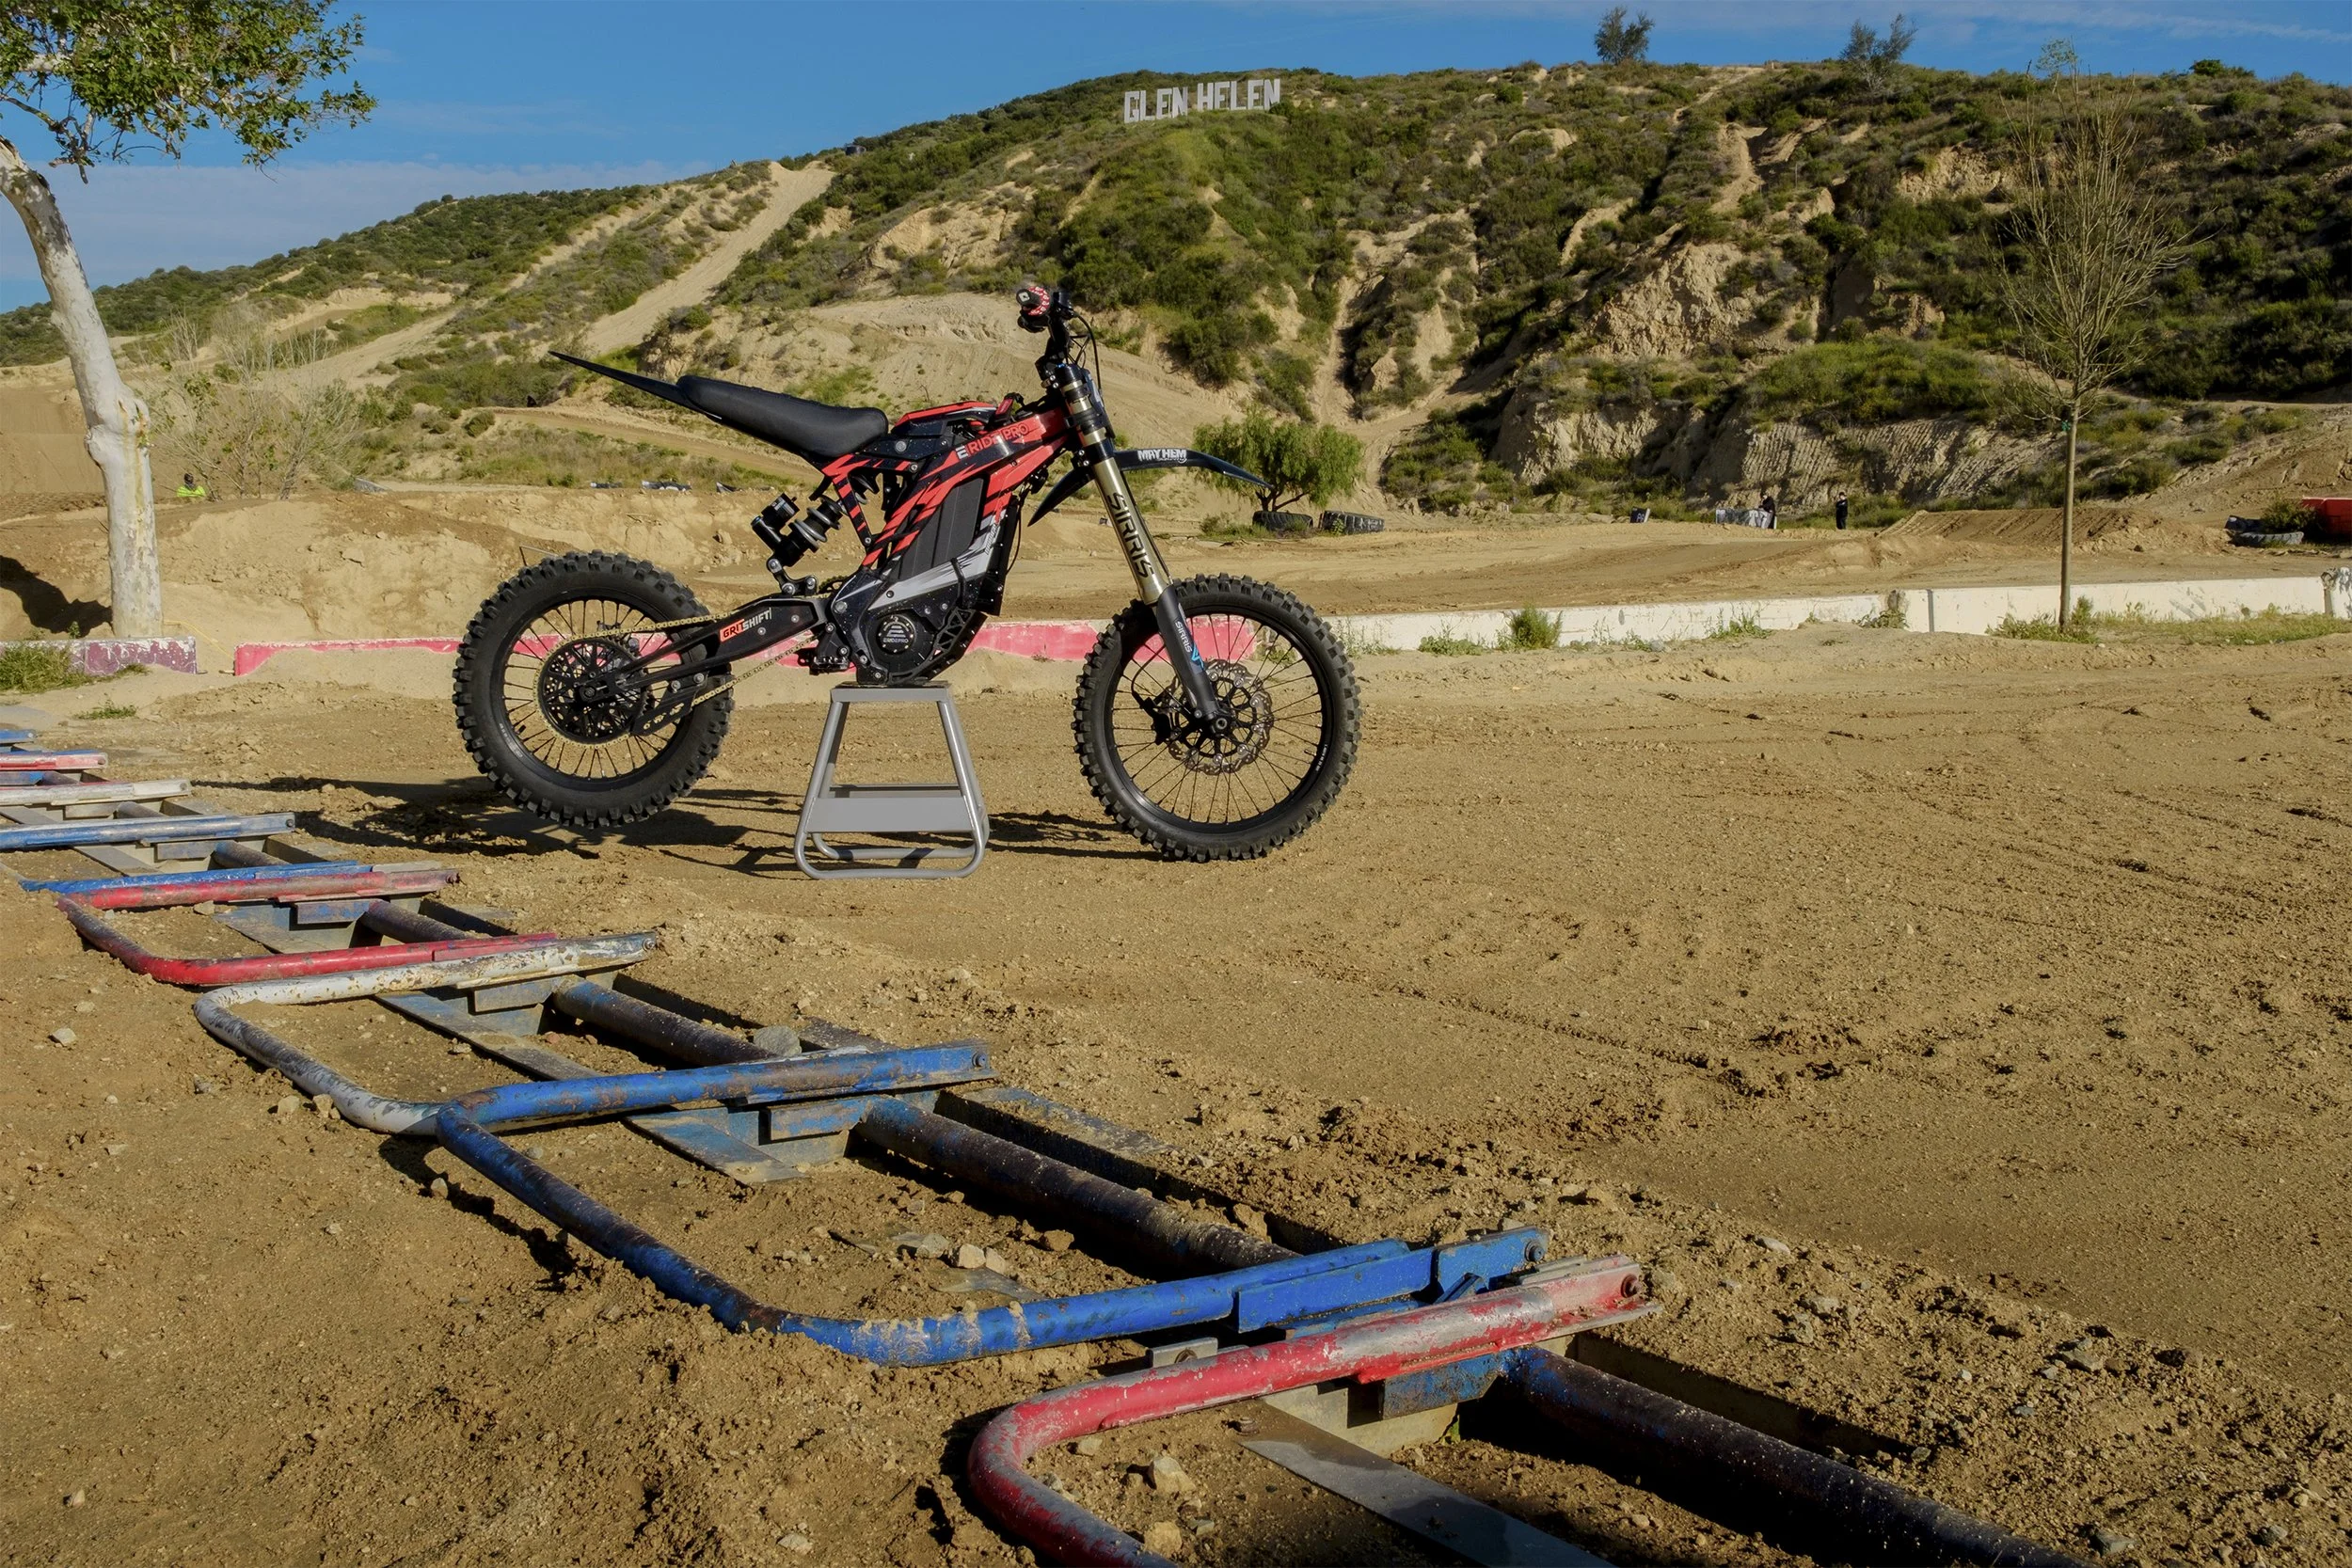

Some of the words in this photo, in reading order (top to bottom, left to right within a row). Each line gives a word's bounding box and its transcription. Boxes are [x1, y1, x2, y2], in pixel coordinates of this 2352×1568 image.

[1124, 86, 1188, 123] GLEN
[1197, 78, 1280, 112] HELEN
[1002, 423, 1029, 440] PRO
[1137, 449, 1187, 462] MAYHEM
[1106, 492, 1155, 578] SIRRIS
[1175, 621, 1193, 653] SIRRIS
